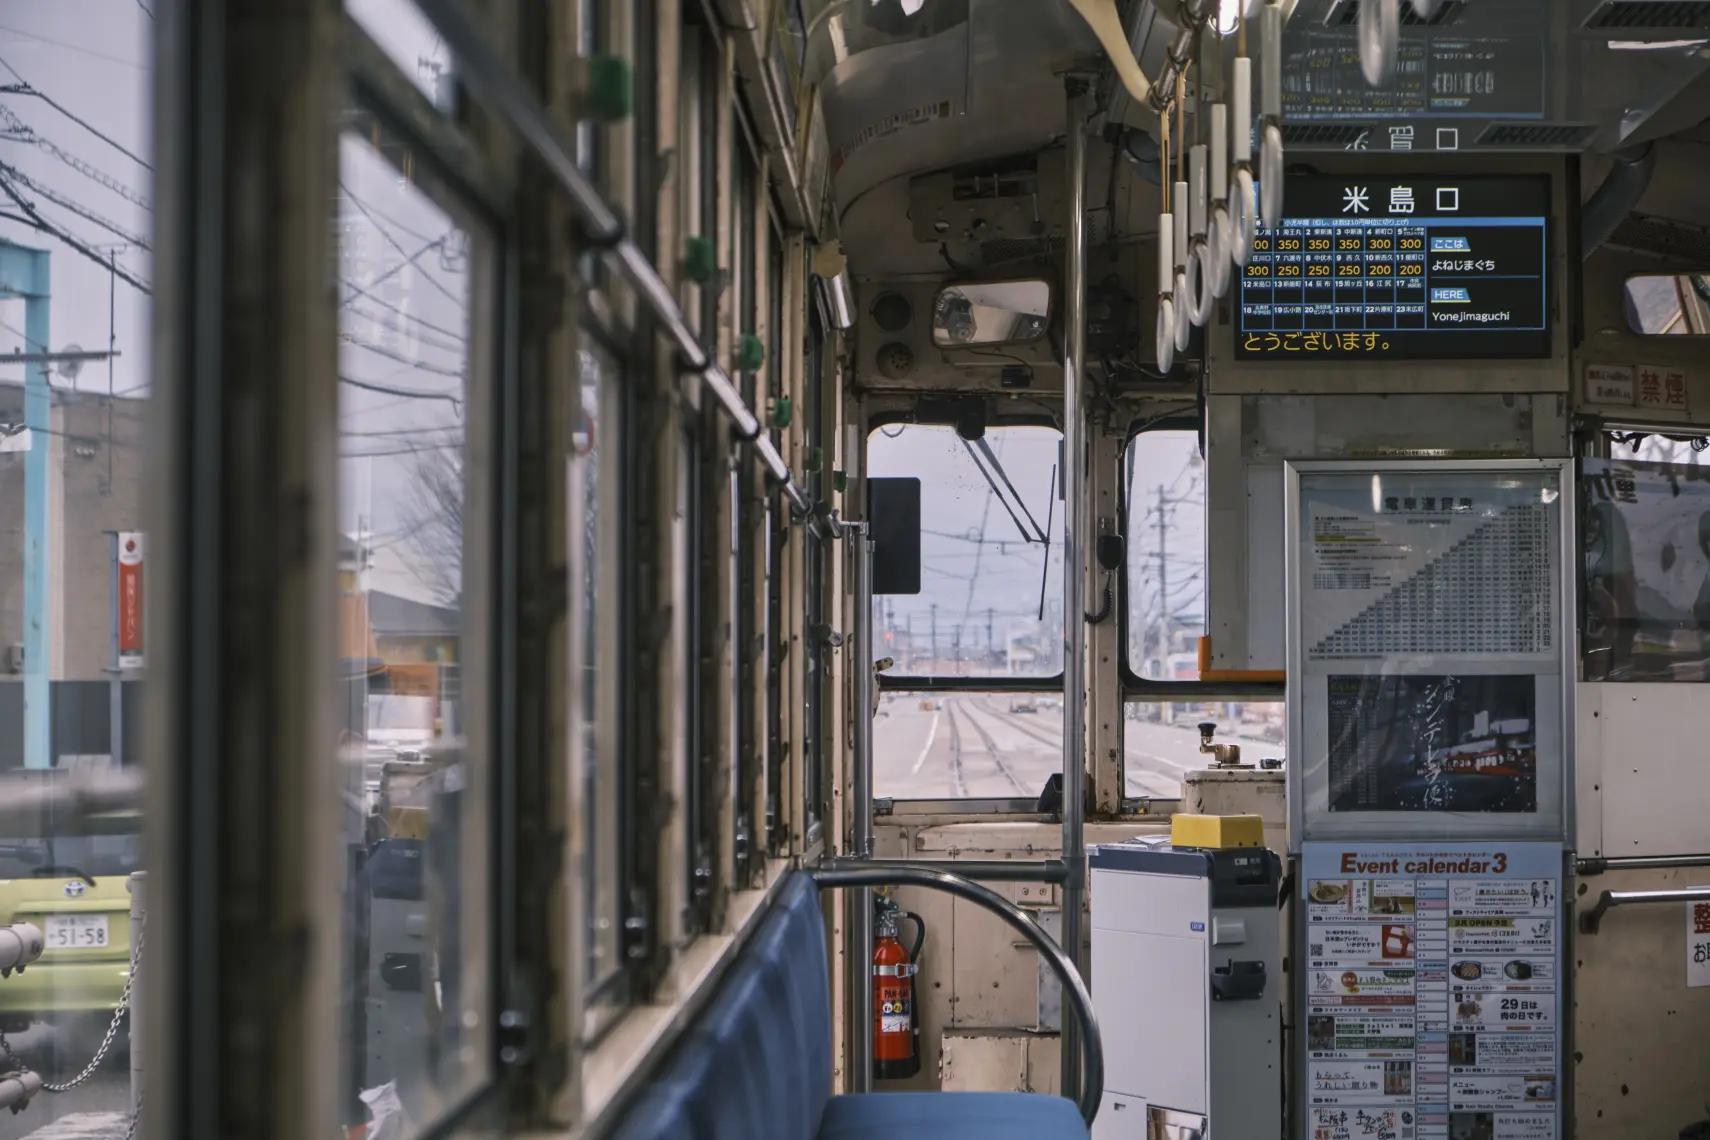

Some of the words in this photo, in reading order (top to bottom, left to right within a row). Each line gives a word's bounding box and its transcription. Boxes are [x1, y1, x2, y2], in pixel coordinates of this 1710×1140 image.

[1343, 186, 1458, 213] 米島口
[1253, 240, 1269, 249] 00
[1278, 240, 1300, 249] 350
[1308, 240, 1330, 249] 350
[1339, 240, 1360, 249] 350
[1369, 240, 1391, 249] 300
[1400, 240, 1421, 249] 300
[1434, 239, 1464, 249] ここは
[1432, 259, 1495, 271] よねじまぐち
[1247, 266, 1269, 275] 300
[1278, 266, 1300, 275] 250
[1308, 266, 1330, 275] 250
[1339, 266, 1360, 275] 250
[1369, 266, 1391, 275] 200
[1399, 266, 1421, 275] 200
[1434, 290, 1464, 299] HERE
[1432, 311, 1510, 322] Yonejimaguchi
[1244, 332, 1390, 351] とうございます。
[1641, 369, 1684, 405] 禁煙
[1340, 852, 1399, 873] Event
[1404, 857, 1490, 873] calendar
[1492, 852, 1507, 873] 3
[58, 928, 105, 945] 51-58
[1693, 942, 1710, 963] お
[1500, 998, 1538, 1010] 29日は
[1500, 1012, 1548, 1021] 肉の日です。
